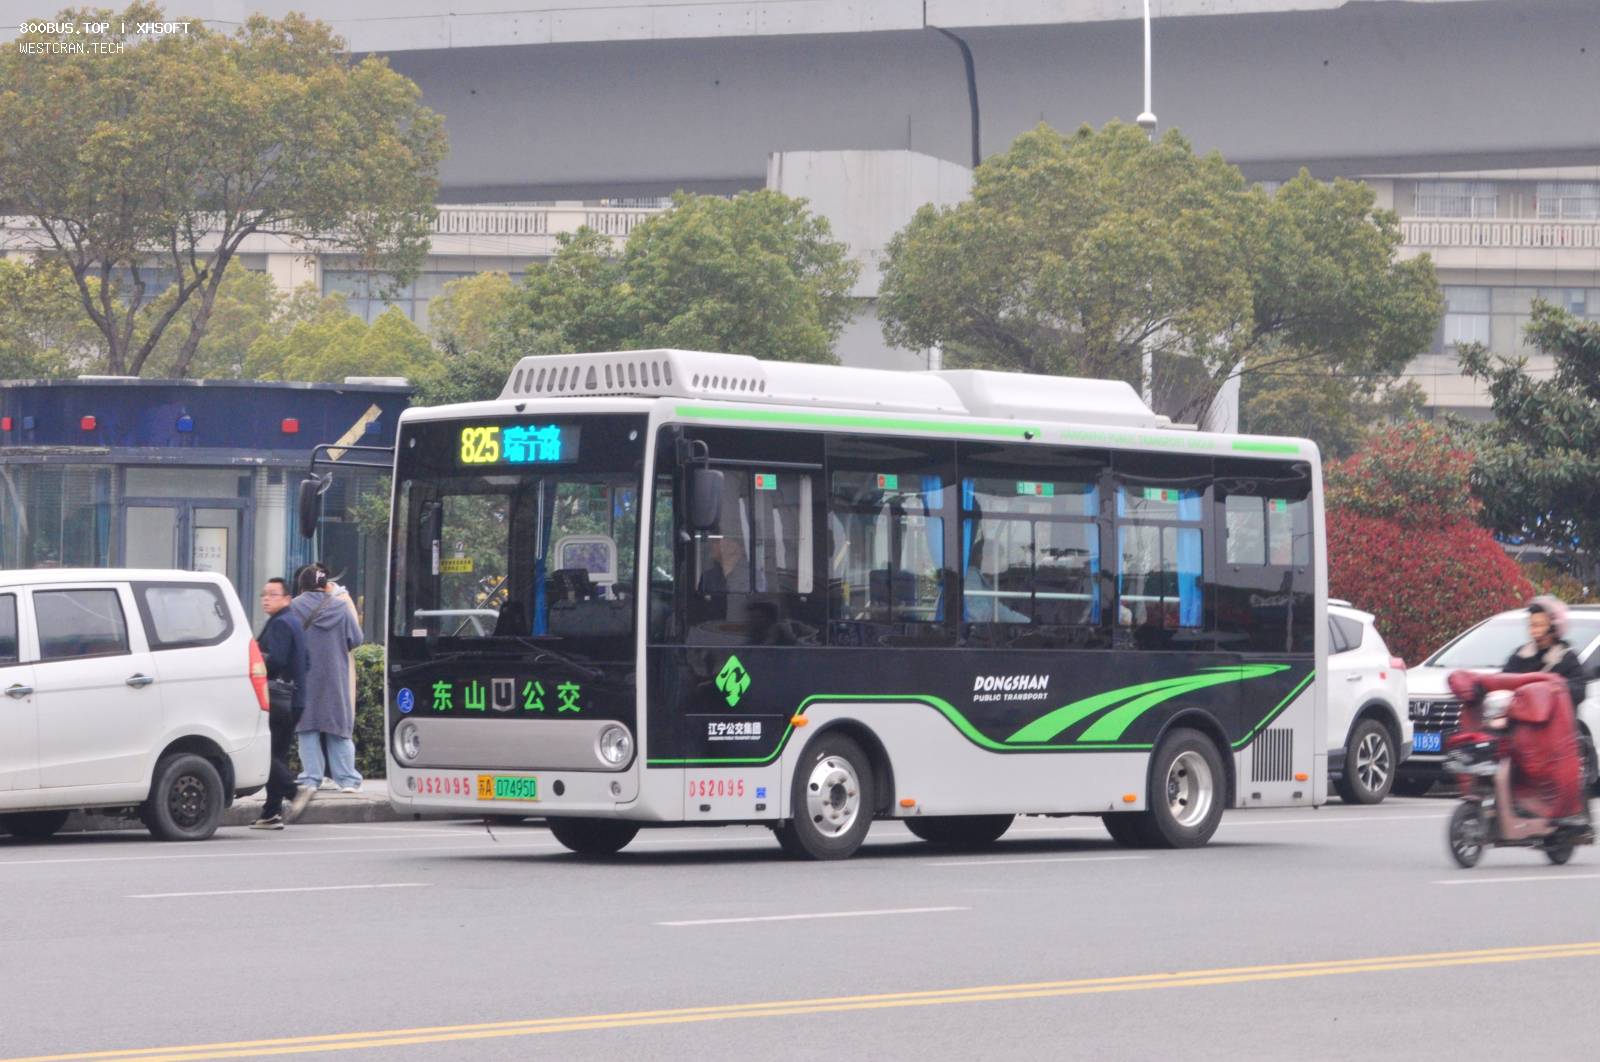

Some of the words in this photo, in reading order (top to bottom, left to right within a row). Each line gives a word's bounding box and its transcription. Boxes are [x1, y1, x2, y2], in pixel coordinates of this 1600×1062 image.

[461, 426, 499, 463] 825
[973, 674, 1050, 691] DONGSHAN
[973, 693, 1002, 702] PUBLIC
[1003, 692, 1049, 702] TRANSPORT
[708, 721, 762, 735] 江宁公交集团
